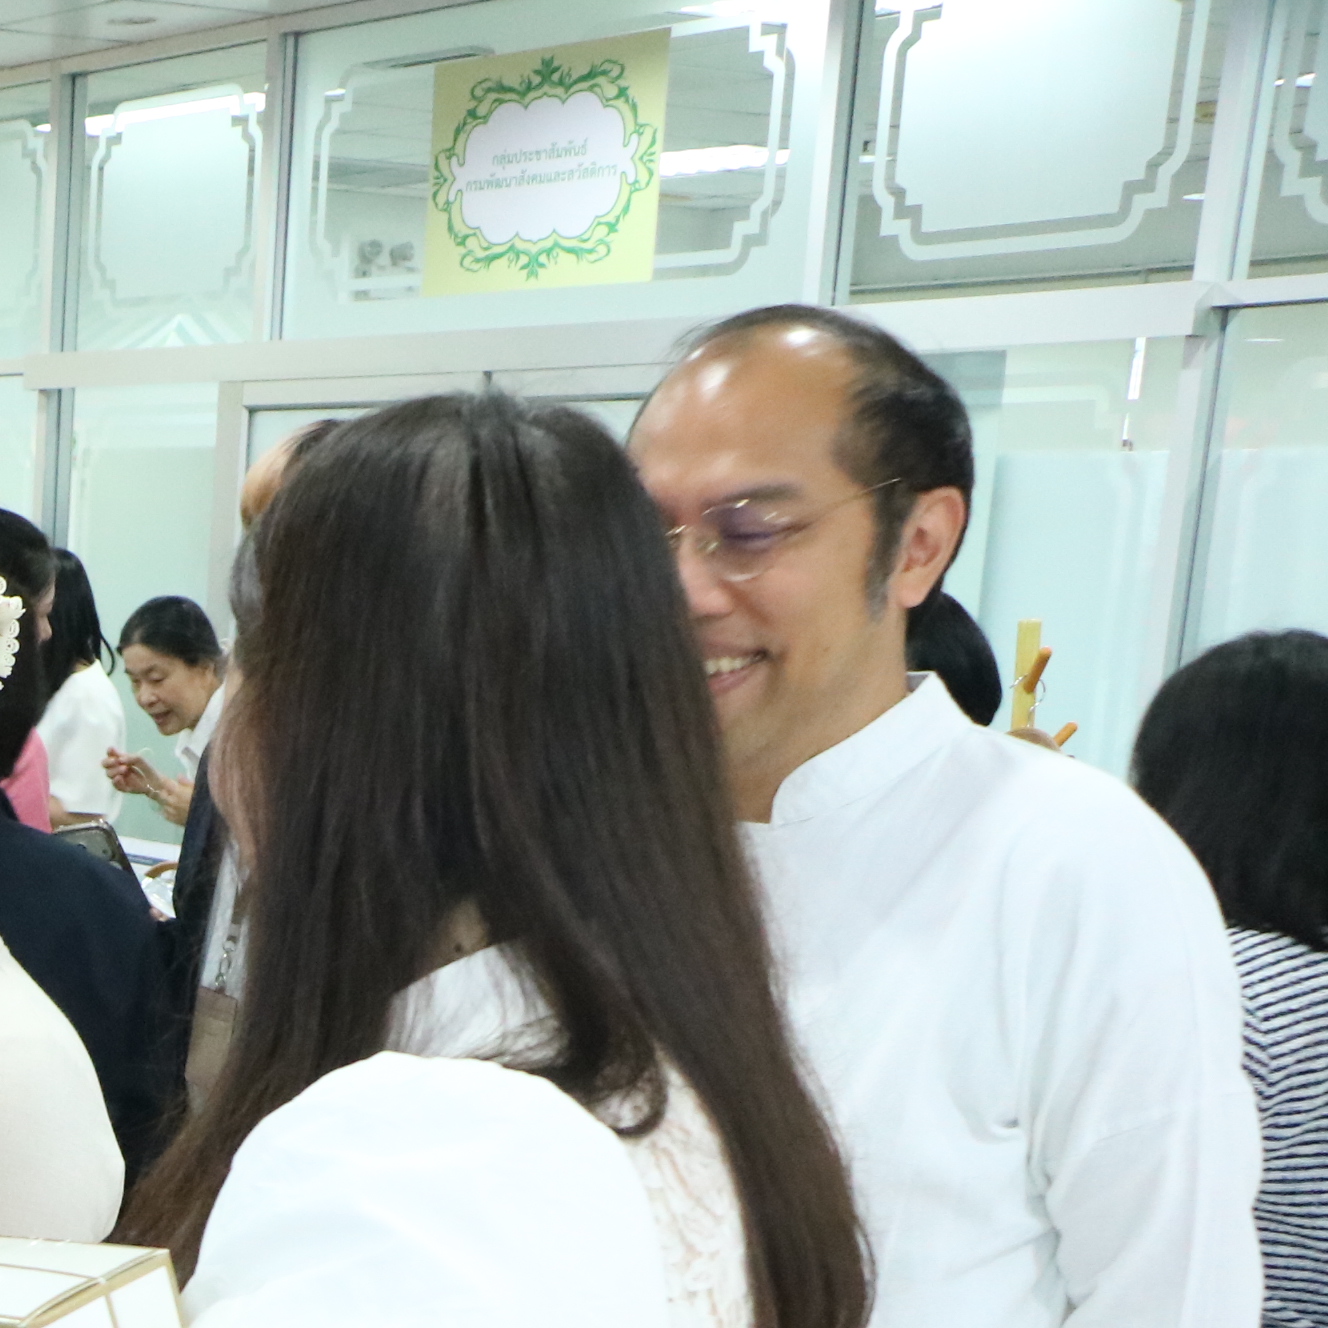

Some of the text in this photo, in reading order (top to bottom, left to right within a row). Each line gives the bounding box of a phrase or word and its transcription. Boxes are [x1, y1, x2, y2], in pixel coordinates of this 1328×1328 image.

[492, 138, 588, 170] กลุ่มประชาสัมพันธ์
[465, 161, 618, 192] กรมพัฒนาสังคมและสวัสดิการ
